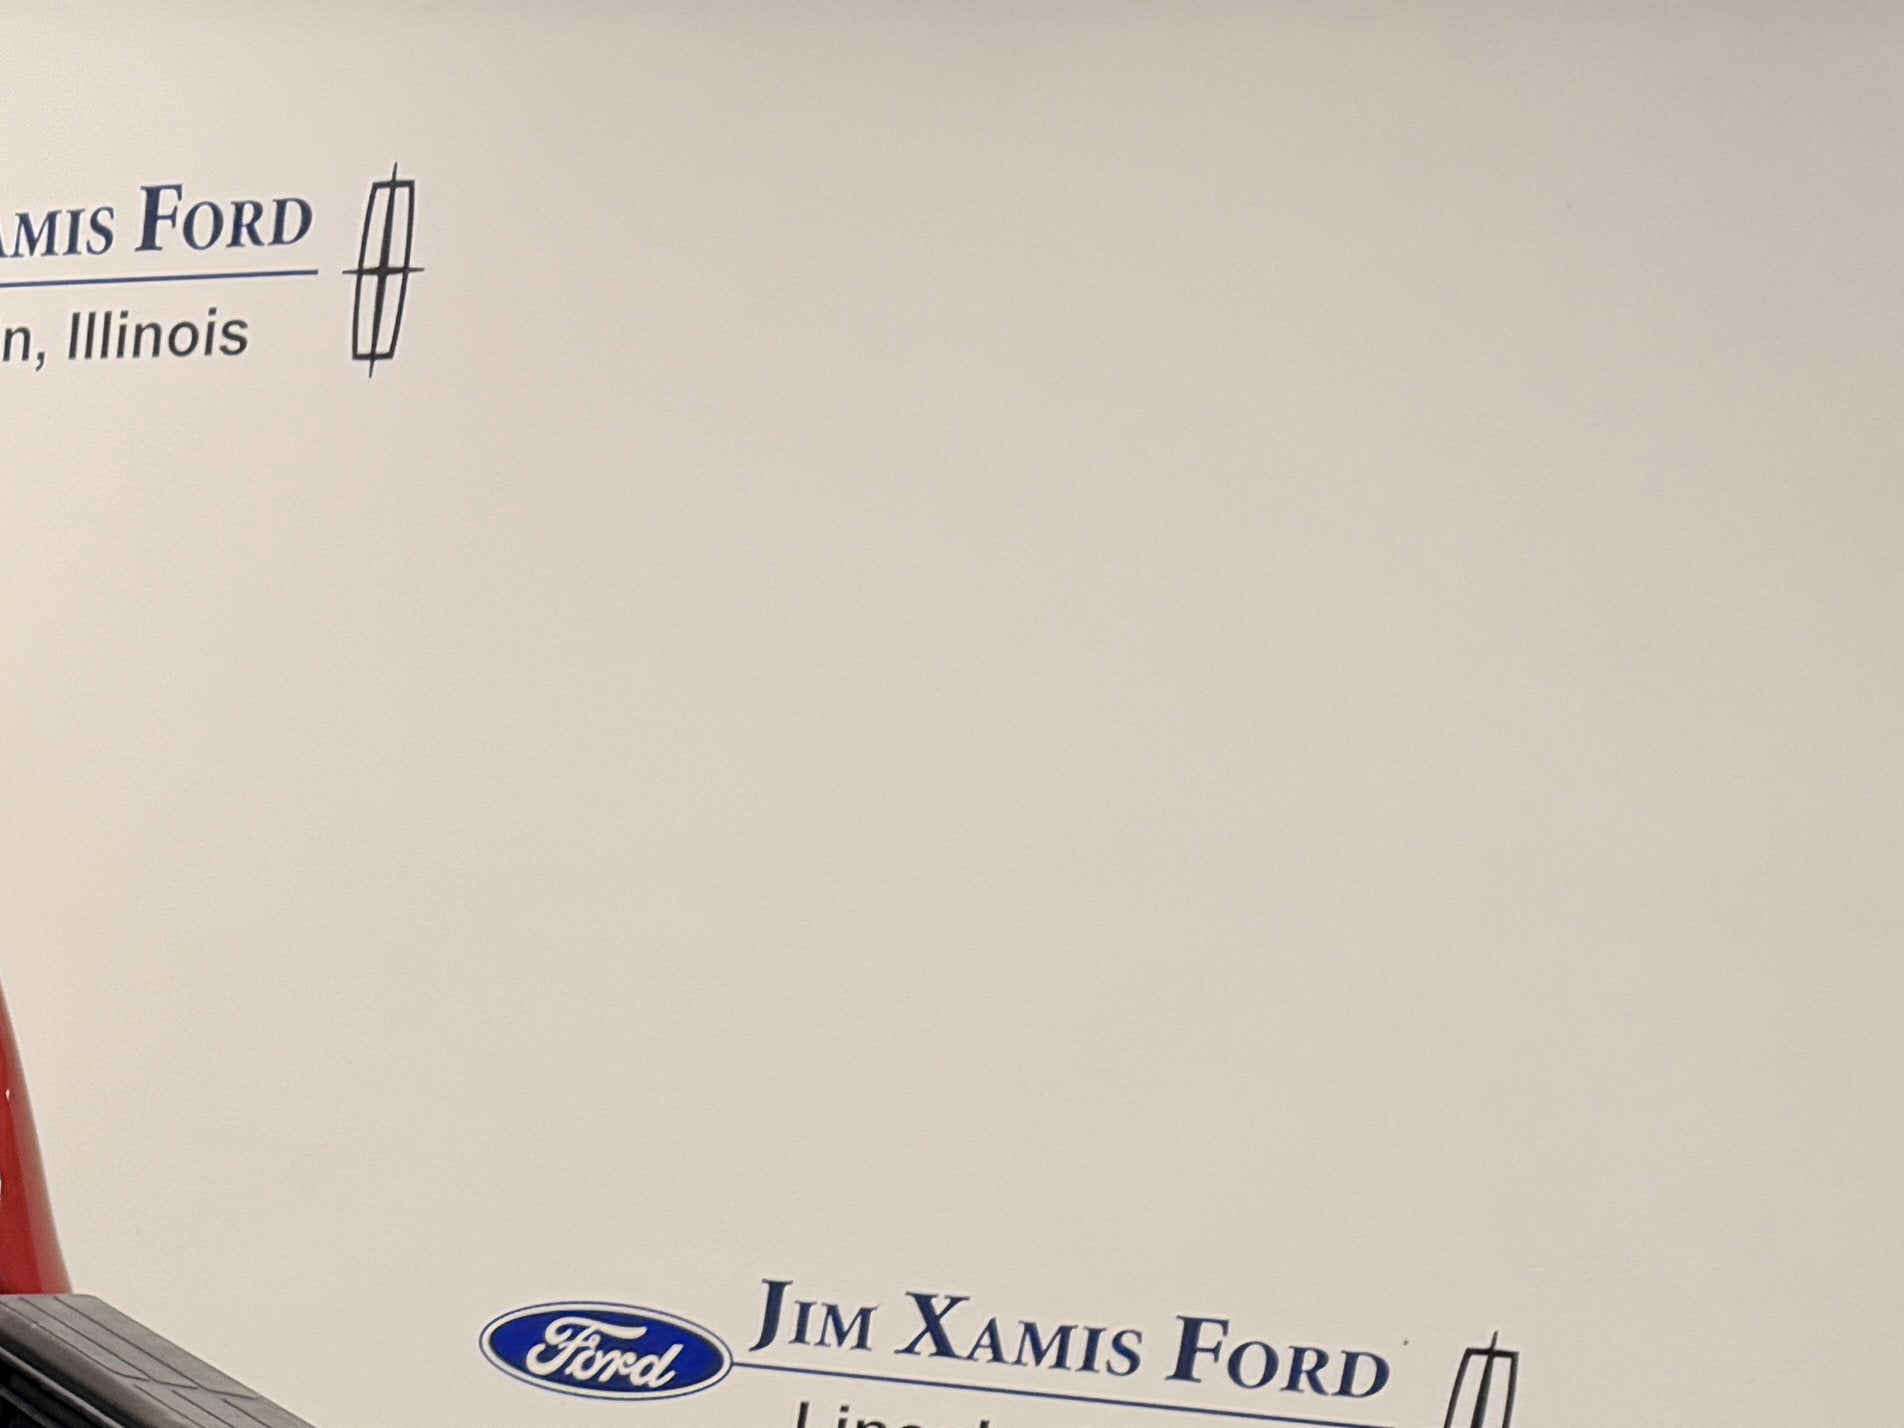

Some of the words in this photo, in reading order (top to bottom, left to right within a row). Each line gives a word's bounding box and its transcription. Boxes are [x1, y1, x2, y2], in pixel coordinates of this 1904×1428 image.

[134, 183, 313, 253] FORD
[68, 306, 248, 360] Illinois
[525, 1316, 684, 1388] Ford
[747, 1278, 879, 1352] JIM
[893, 1291, 1143, 1377] XAMIS
[1165, 1314, 1391, 1399] FORD
